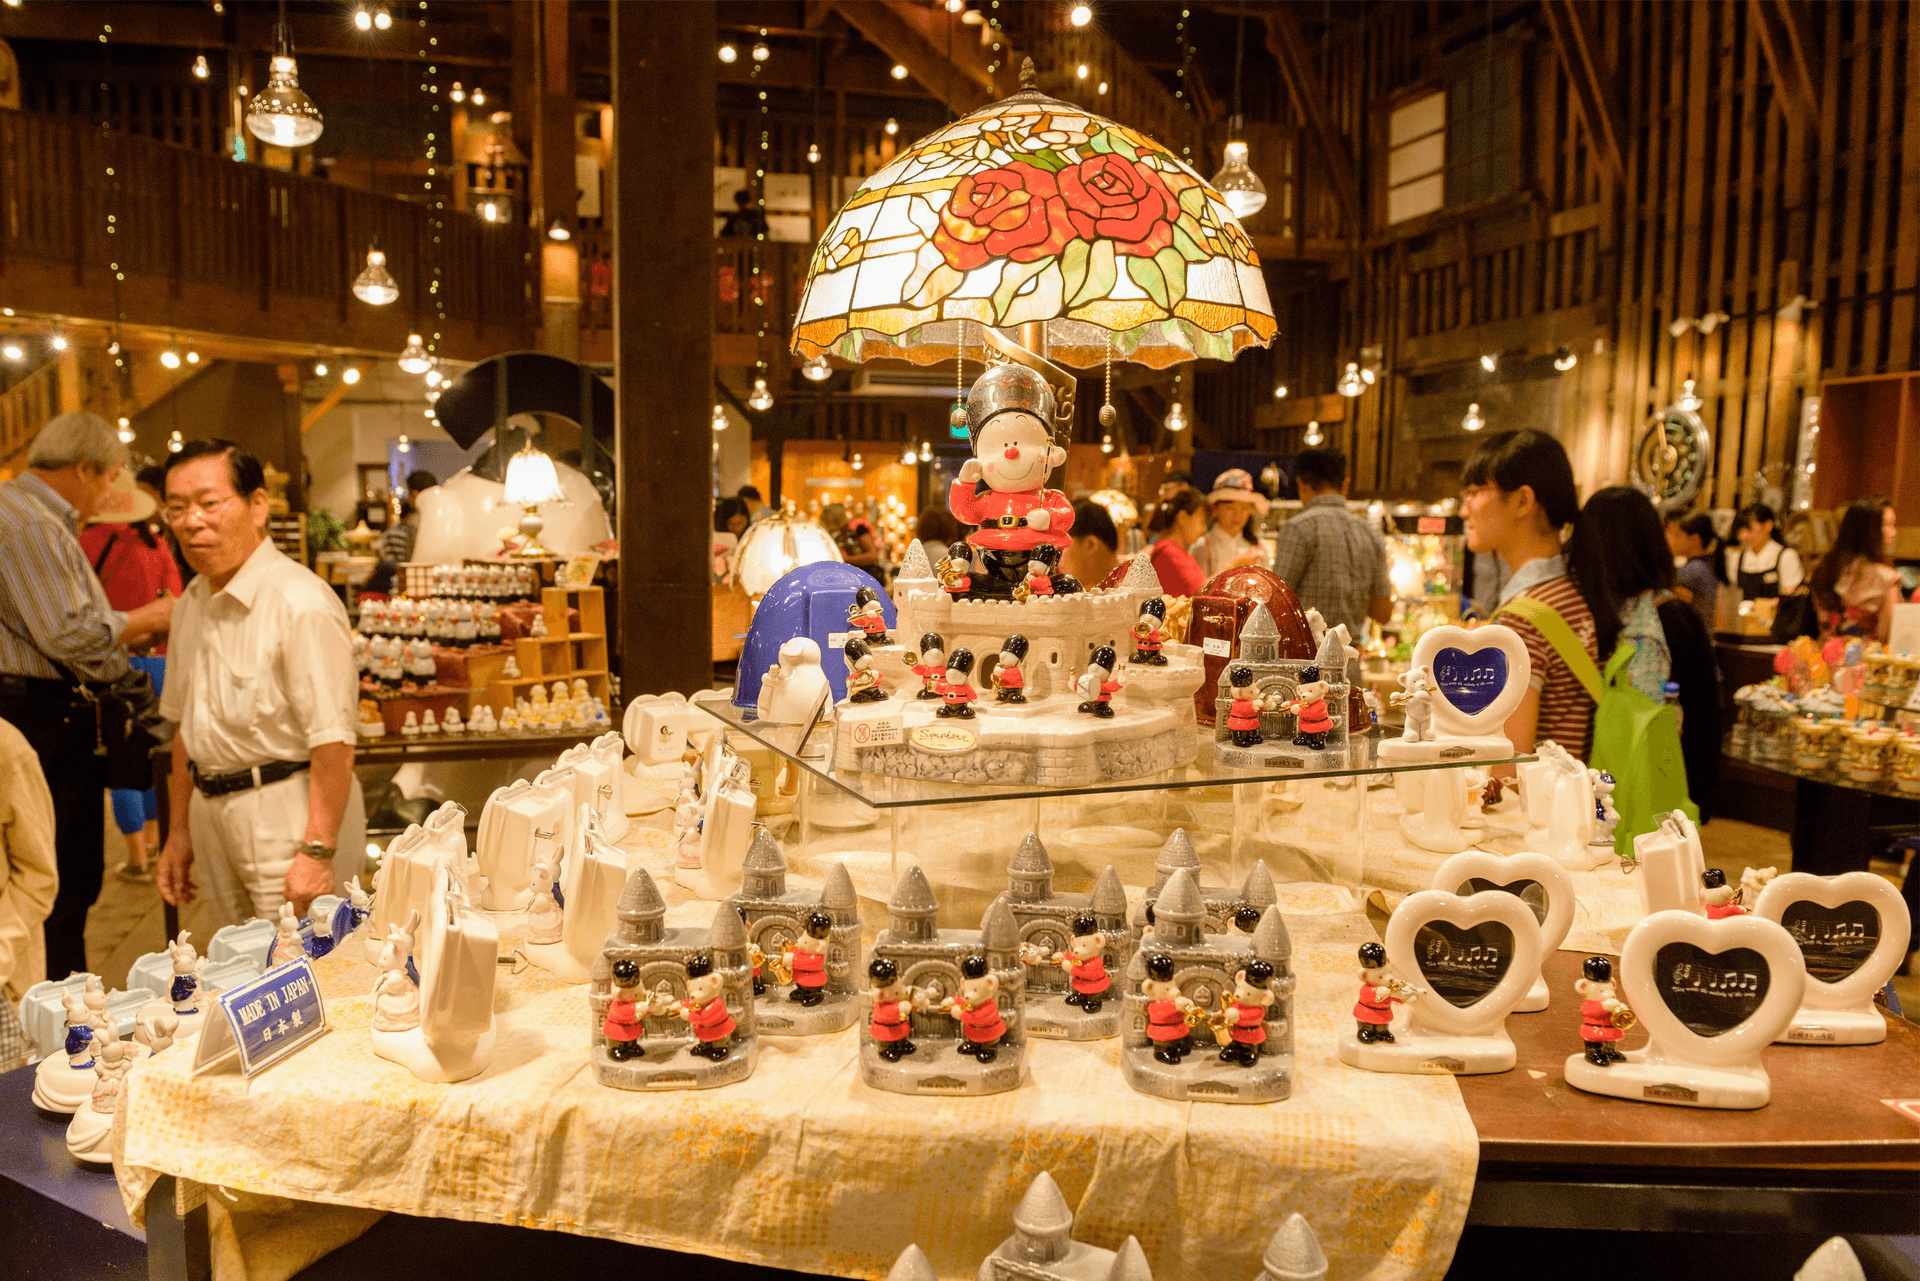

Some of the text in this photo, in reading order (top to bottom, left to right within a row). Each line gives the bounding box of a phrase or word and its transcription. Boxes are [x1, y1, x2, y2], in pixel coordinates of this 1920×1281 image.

[919, 729, 969, 743] Symphony
[237, 976, 311, 1026] MADE IN JAPAN
[262, 1010, 304, 1042] 日本製
